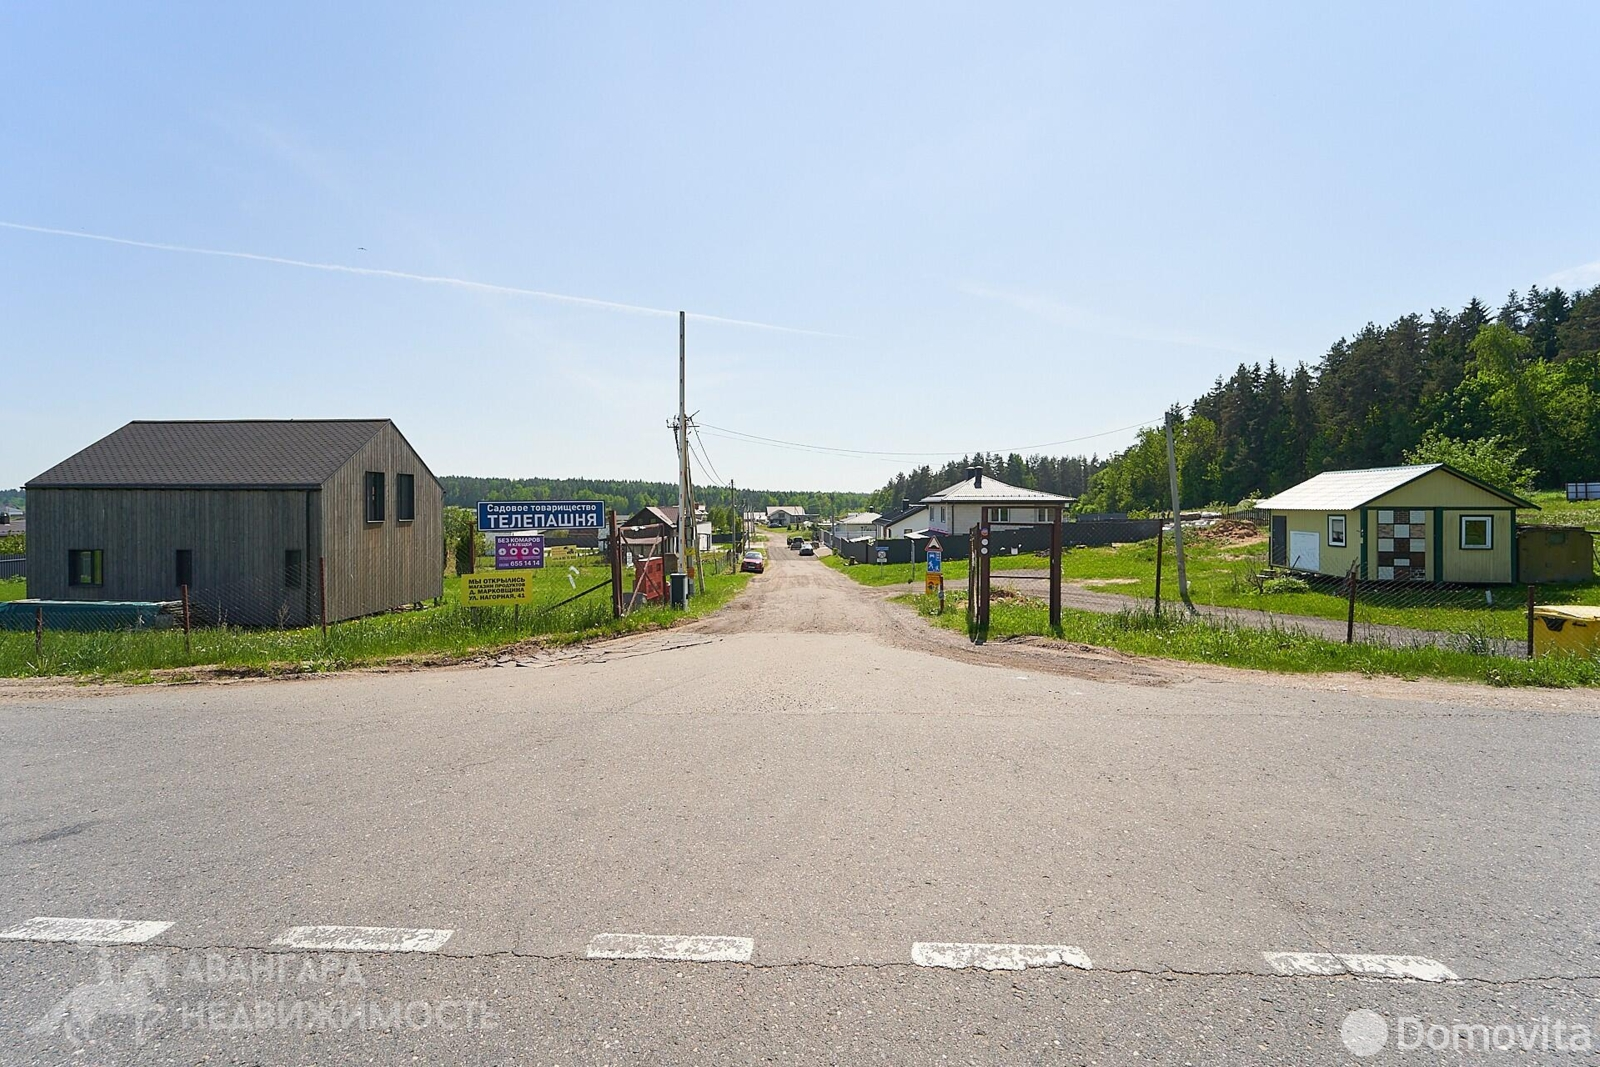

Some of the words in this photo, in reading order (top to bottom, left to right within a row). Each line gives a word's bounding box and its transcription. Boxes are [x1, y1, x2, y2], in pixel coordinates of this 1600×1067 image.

[487, 504, 528, 512] Садовое
[531, 504, 596, 512] товарищество
[487, 513, 597, 528] ТЕЛЕПАШНЯ
